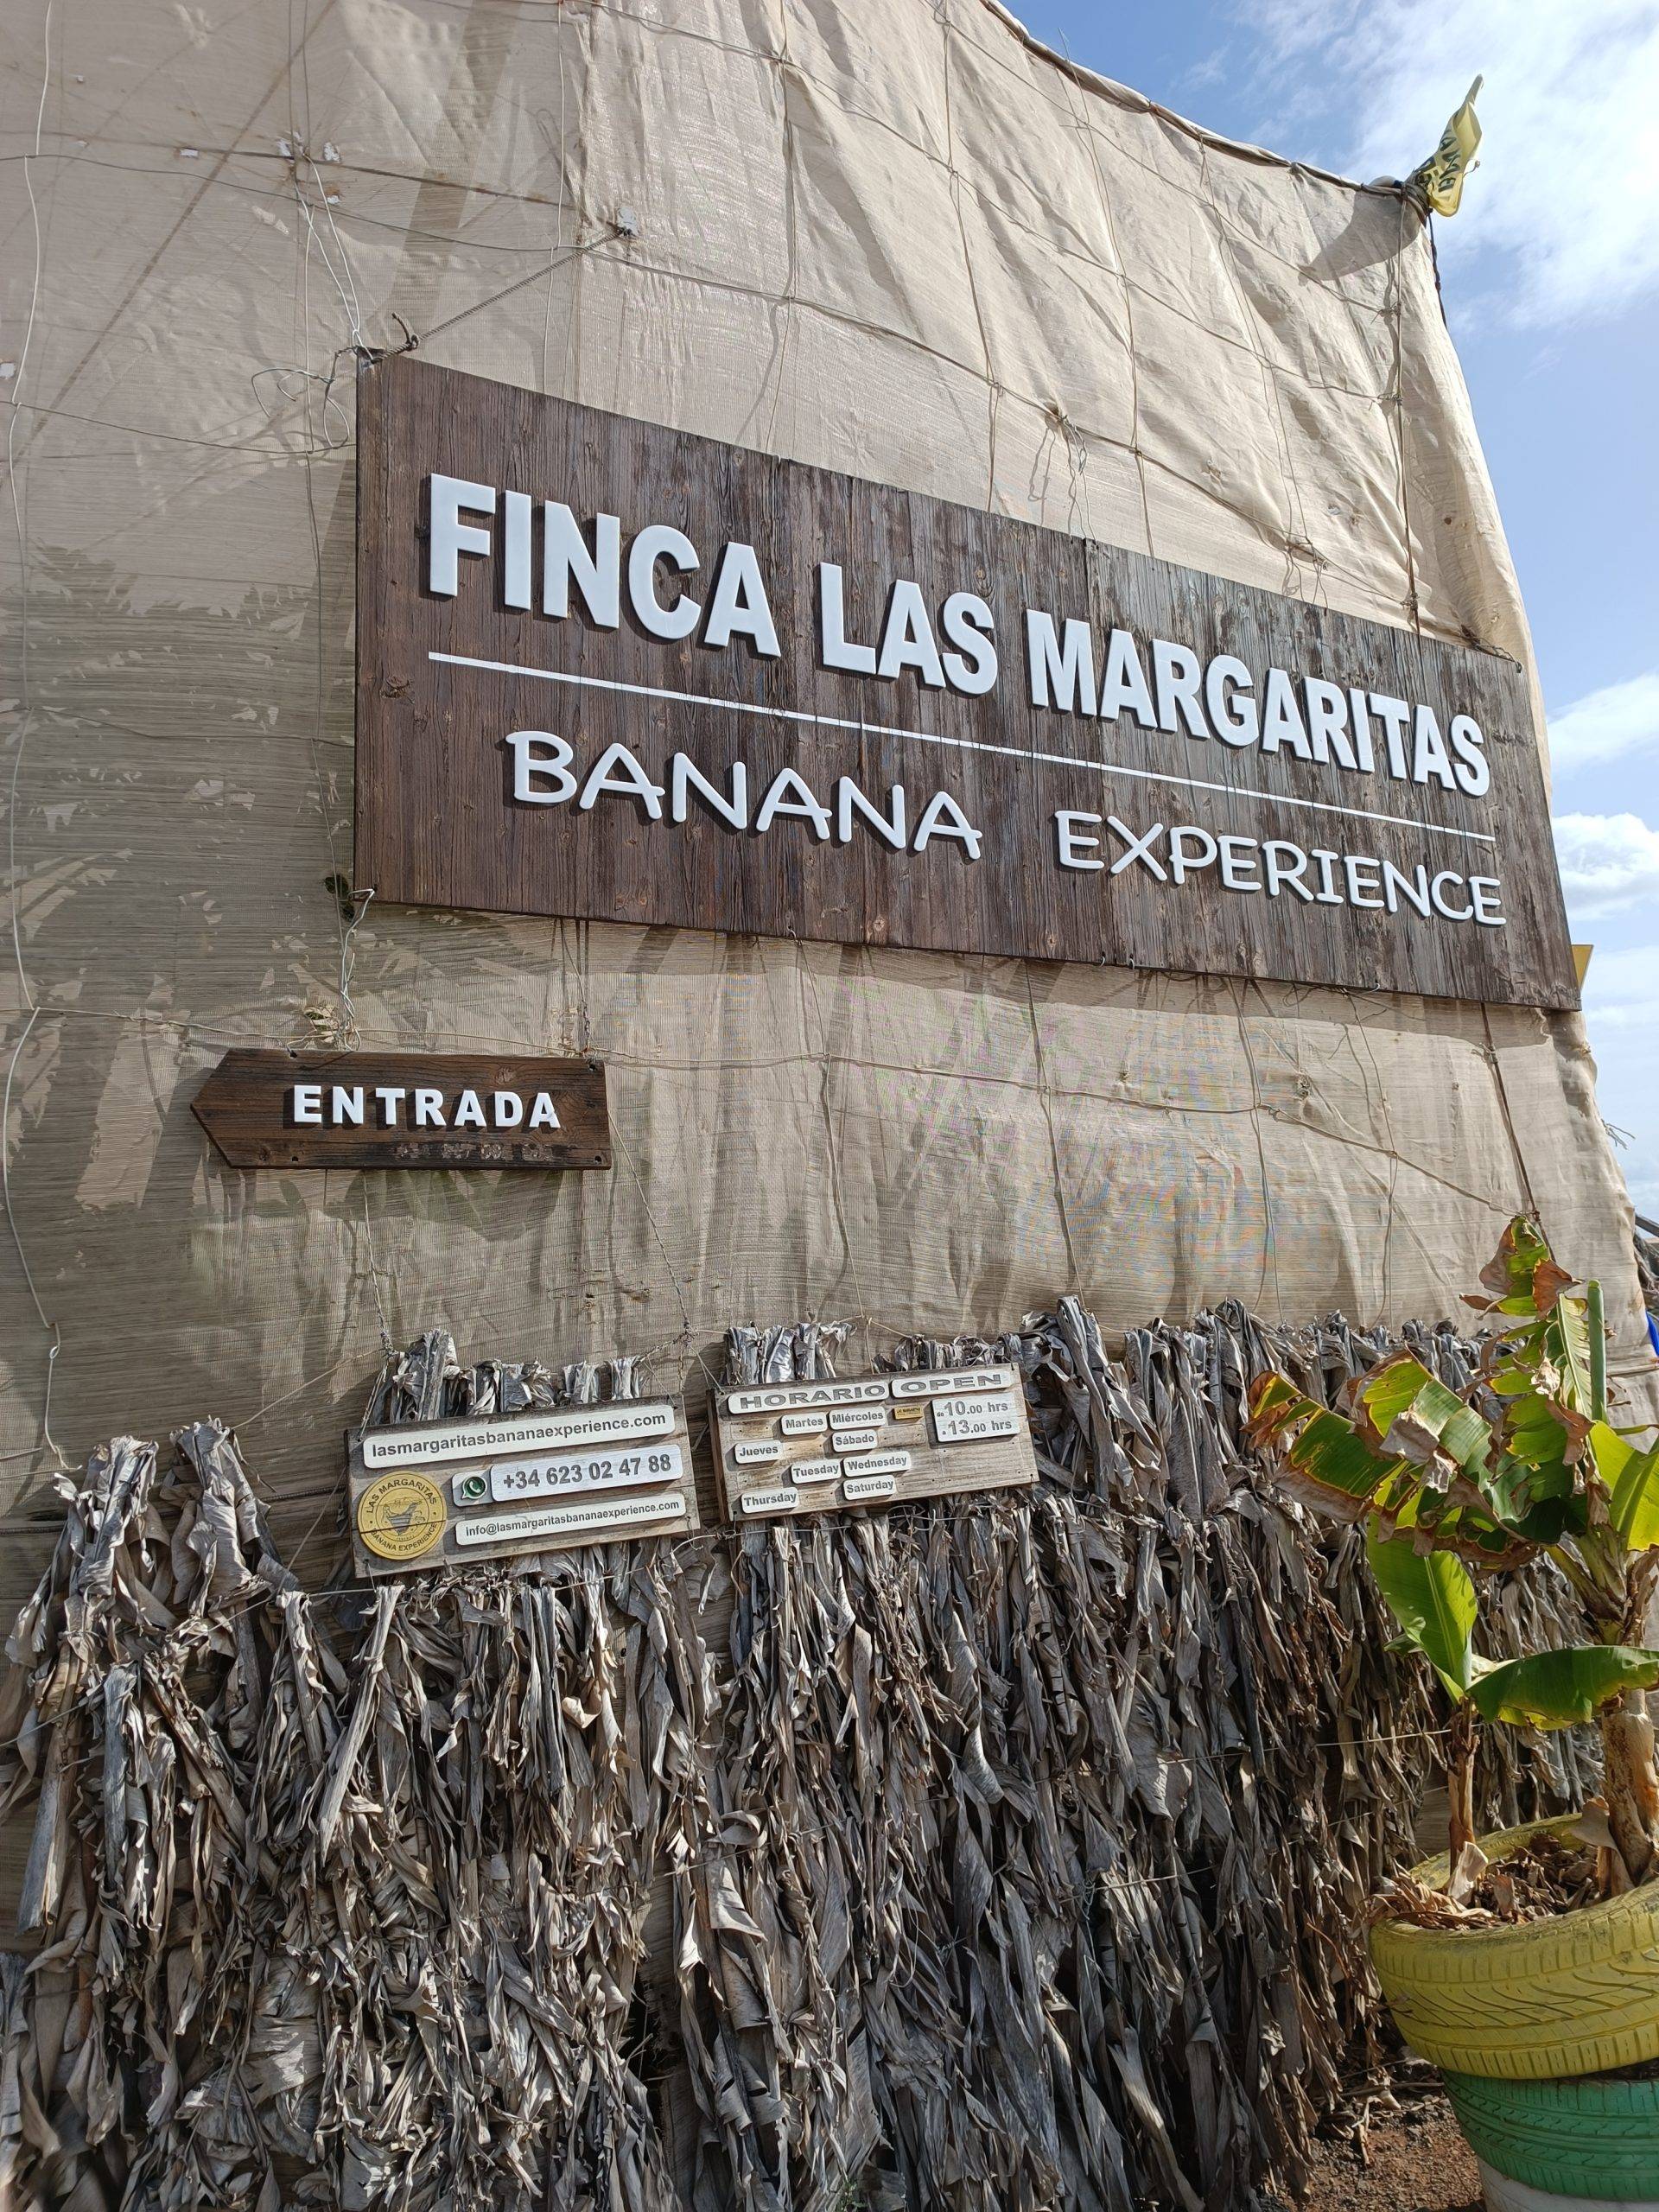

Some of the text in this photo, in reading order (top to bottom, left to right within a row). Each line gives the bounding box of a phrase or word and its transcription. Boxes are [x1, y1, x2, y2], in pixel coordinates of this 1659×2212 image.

[429, 473, 1491, 797] FINCA LAS MARGARITAS
[505, 730, 1507, 925] BANANA EXPERIENCE
[293, 1084, 561, 1128] ENTRADA
[740, 1373, 1002, 1409] HORARIO OPEN
[944, 1401, 983, 1416] 10.00
[987, 1402, 1008, 1413] hrs
[785, 1417, 824, 1429] Martes
[832, 1410, 884, 1424] Miércoles
[948, 1419, 987, 1435] 13.00
[991, 1420, 1013, 1431] hrs
[372, 1413, 666, 1458] lasmargaritasbananaexperience.com
[835, 1434, 875, 1446] Sábado
[739, 1446, 779, 1458] Jueves
[503, 1453, 671, 1490] +34 623 02 47 88
[792, 1464, 840, 1478] Tuesday
[847, 1456, 907, 1471] Wednesday
[846, 1480, 894, 1495] Saturday
[366, 1478, 437, 1514] LAS MARGARITAS
[743, 1492, 798, 1507] Thursday
[465, 1500, 680, 1537] info@lasmargaritasbananaexperience.com
[371, 1522, 438, 1552] BANANA EXPERIENCE
